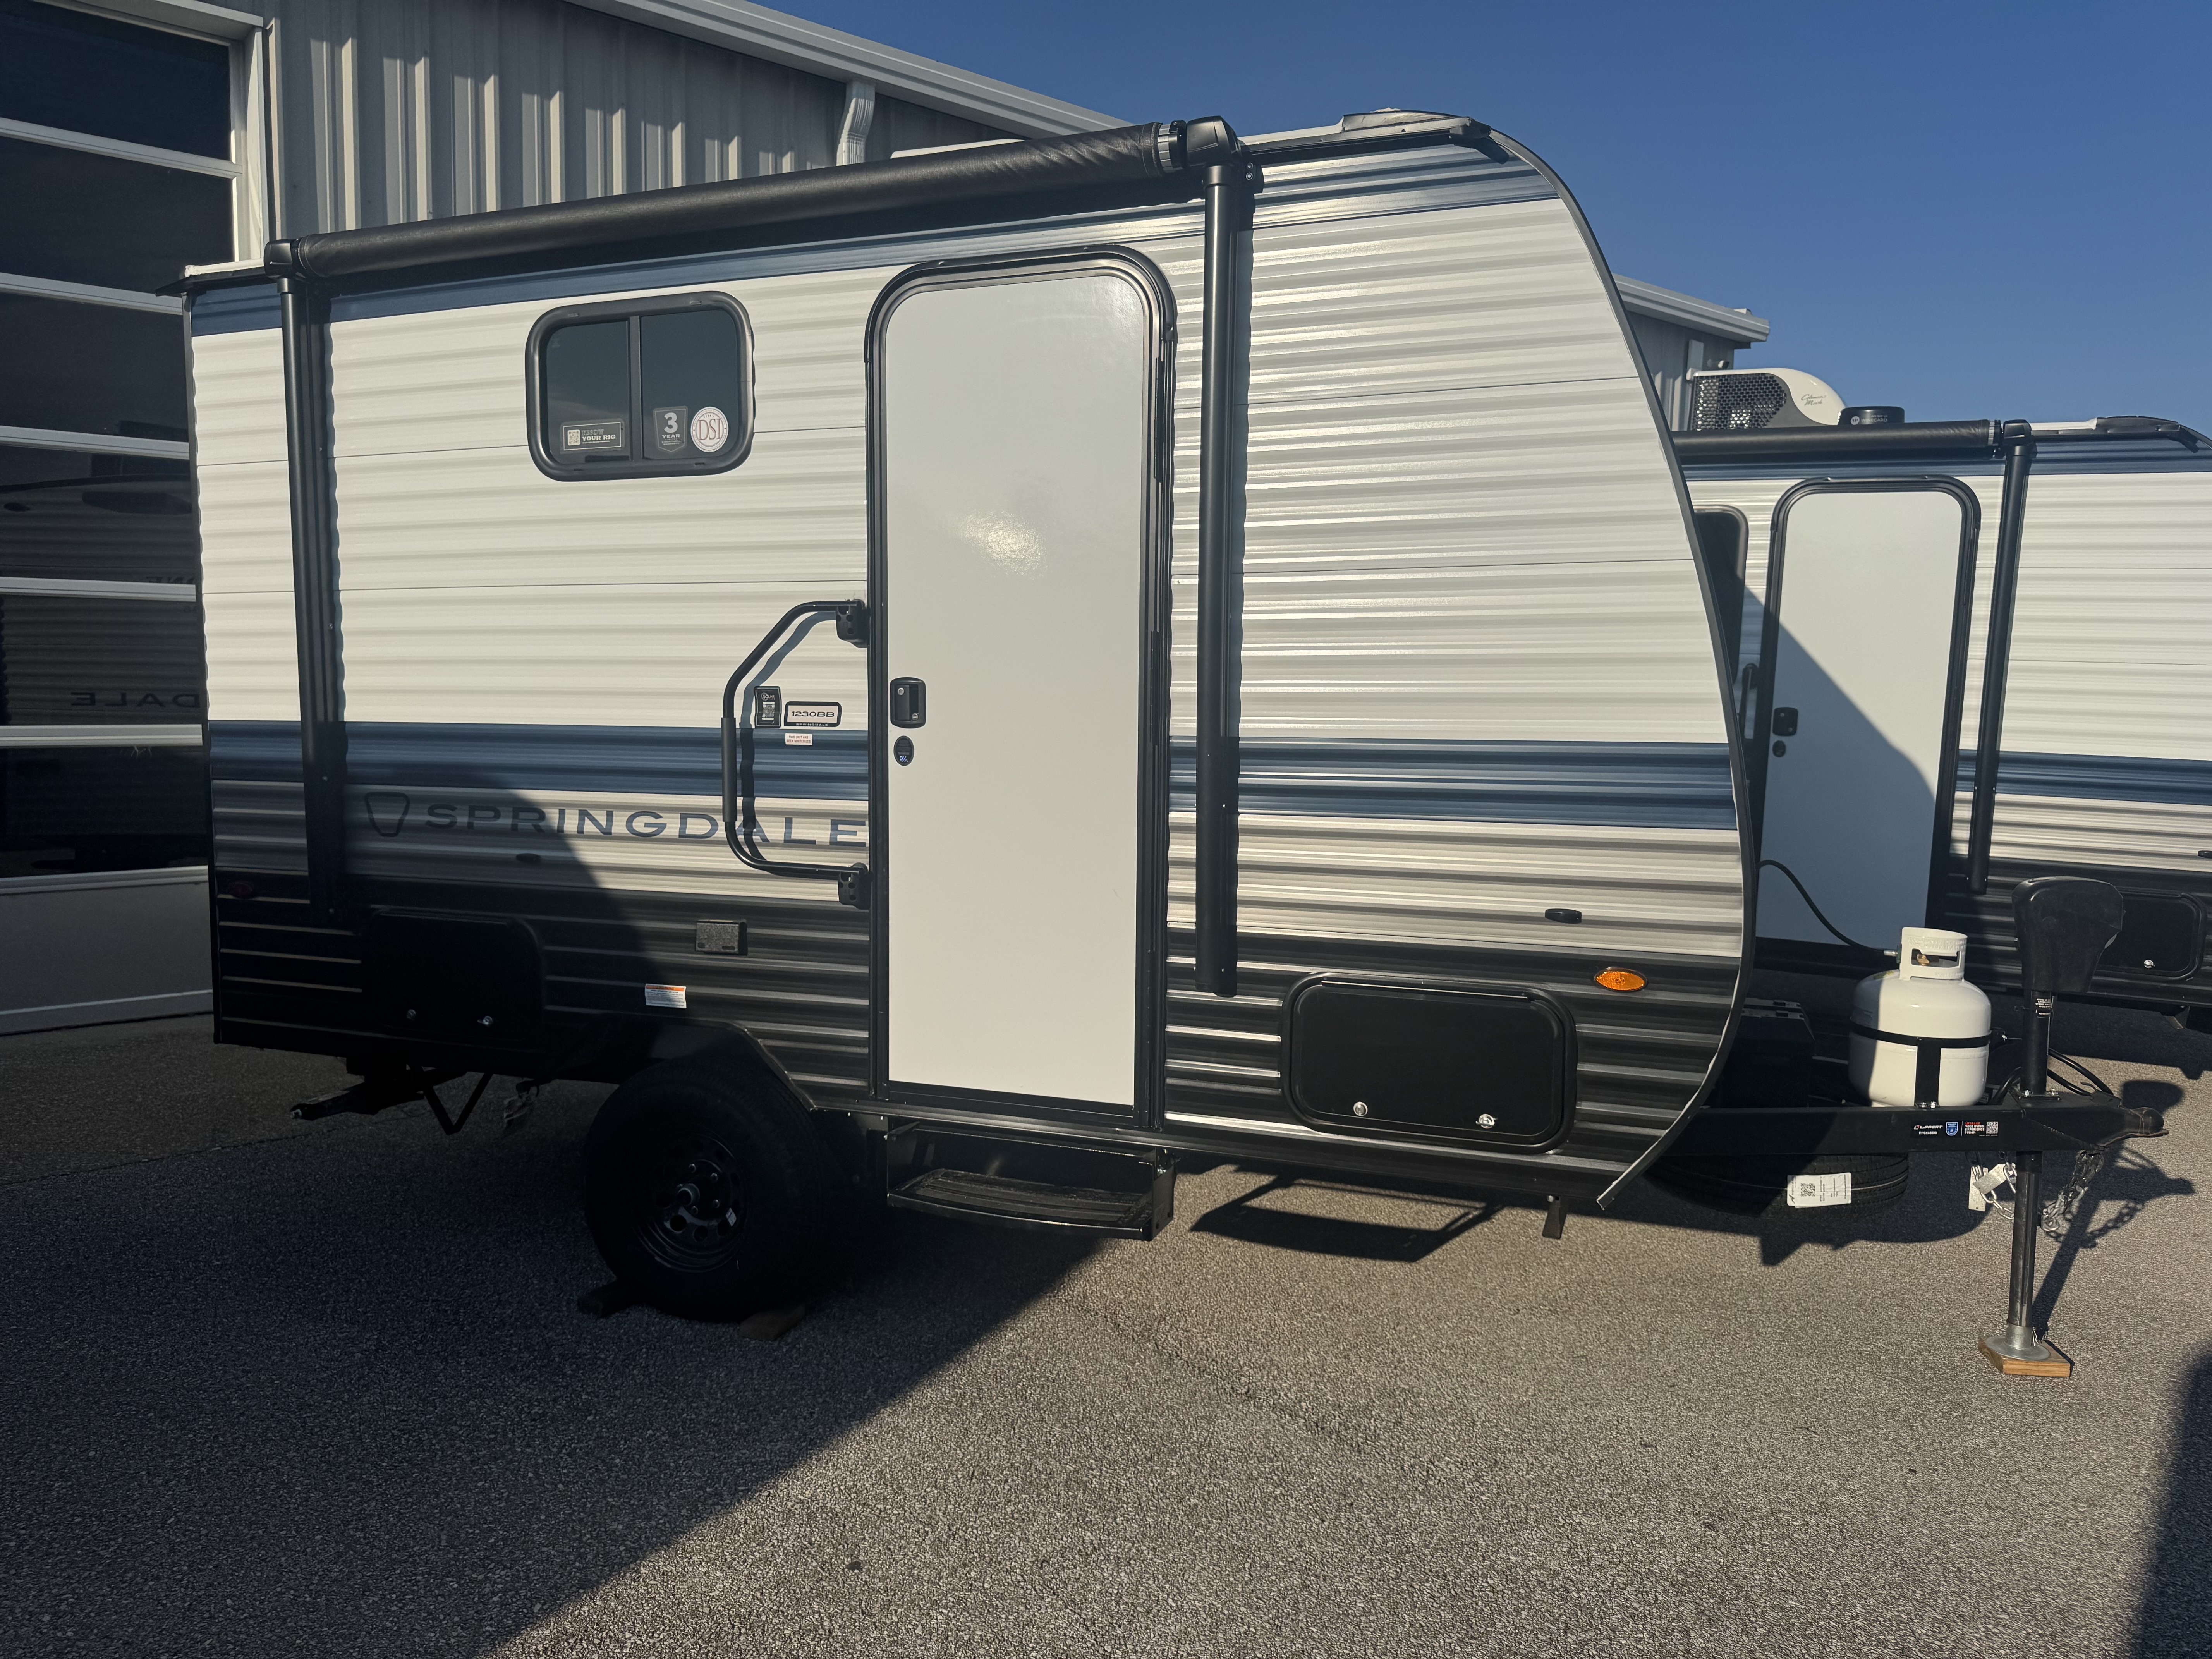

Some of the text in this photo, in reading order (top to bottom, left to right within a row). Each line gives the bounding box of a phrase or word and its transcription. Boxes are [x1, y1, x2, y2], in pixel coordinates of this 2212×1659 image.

[664, 412, 678, 433] 3
[698, 419, 721, 440] DSI
[426, 804, 866, 847] SPRINGDALE
